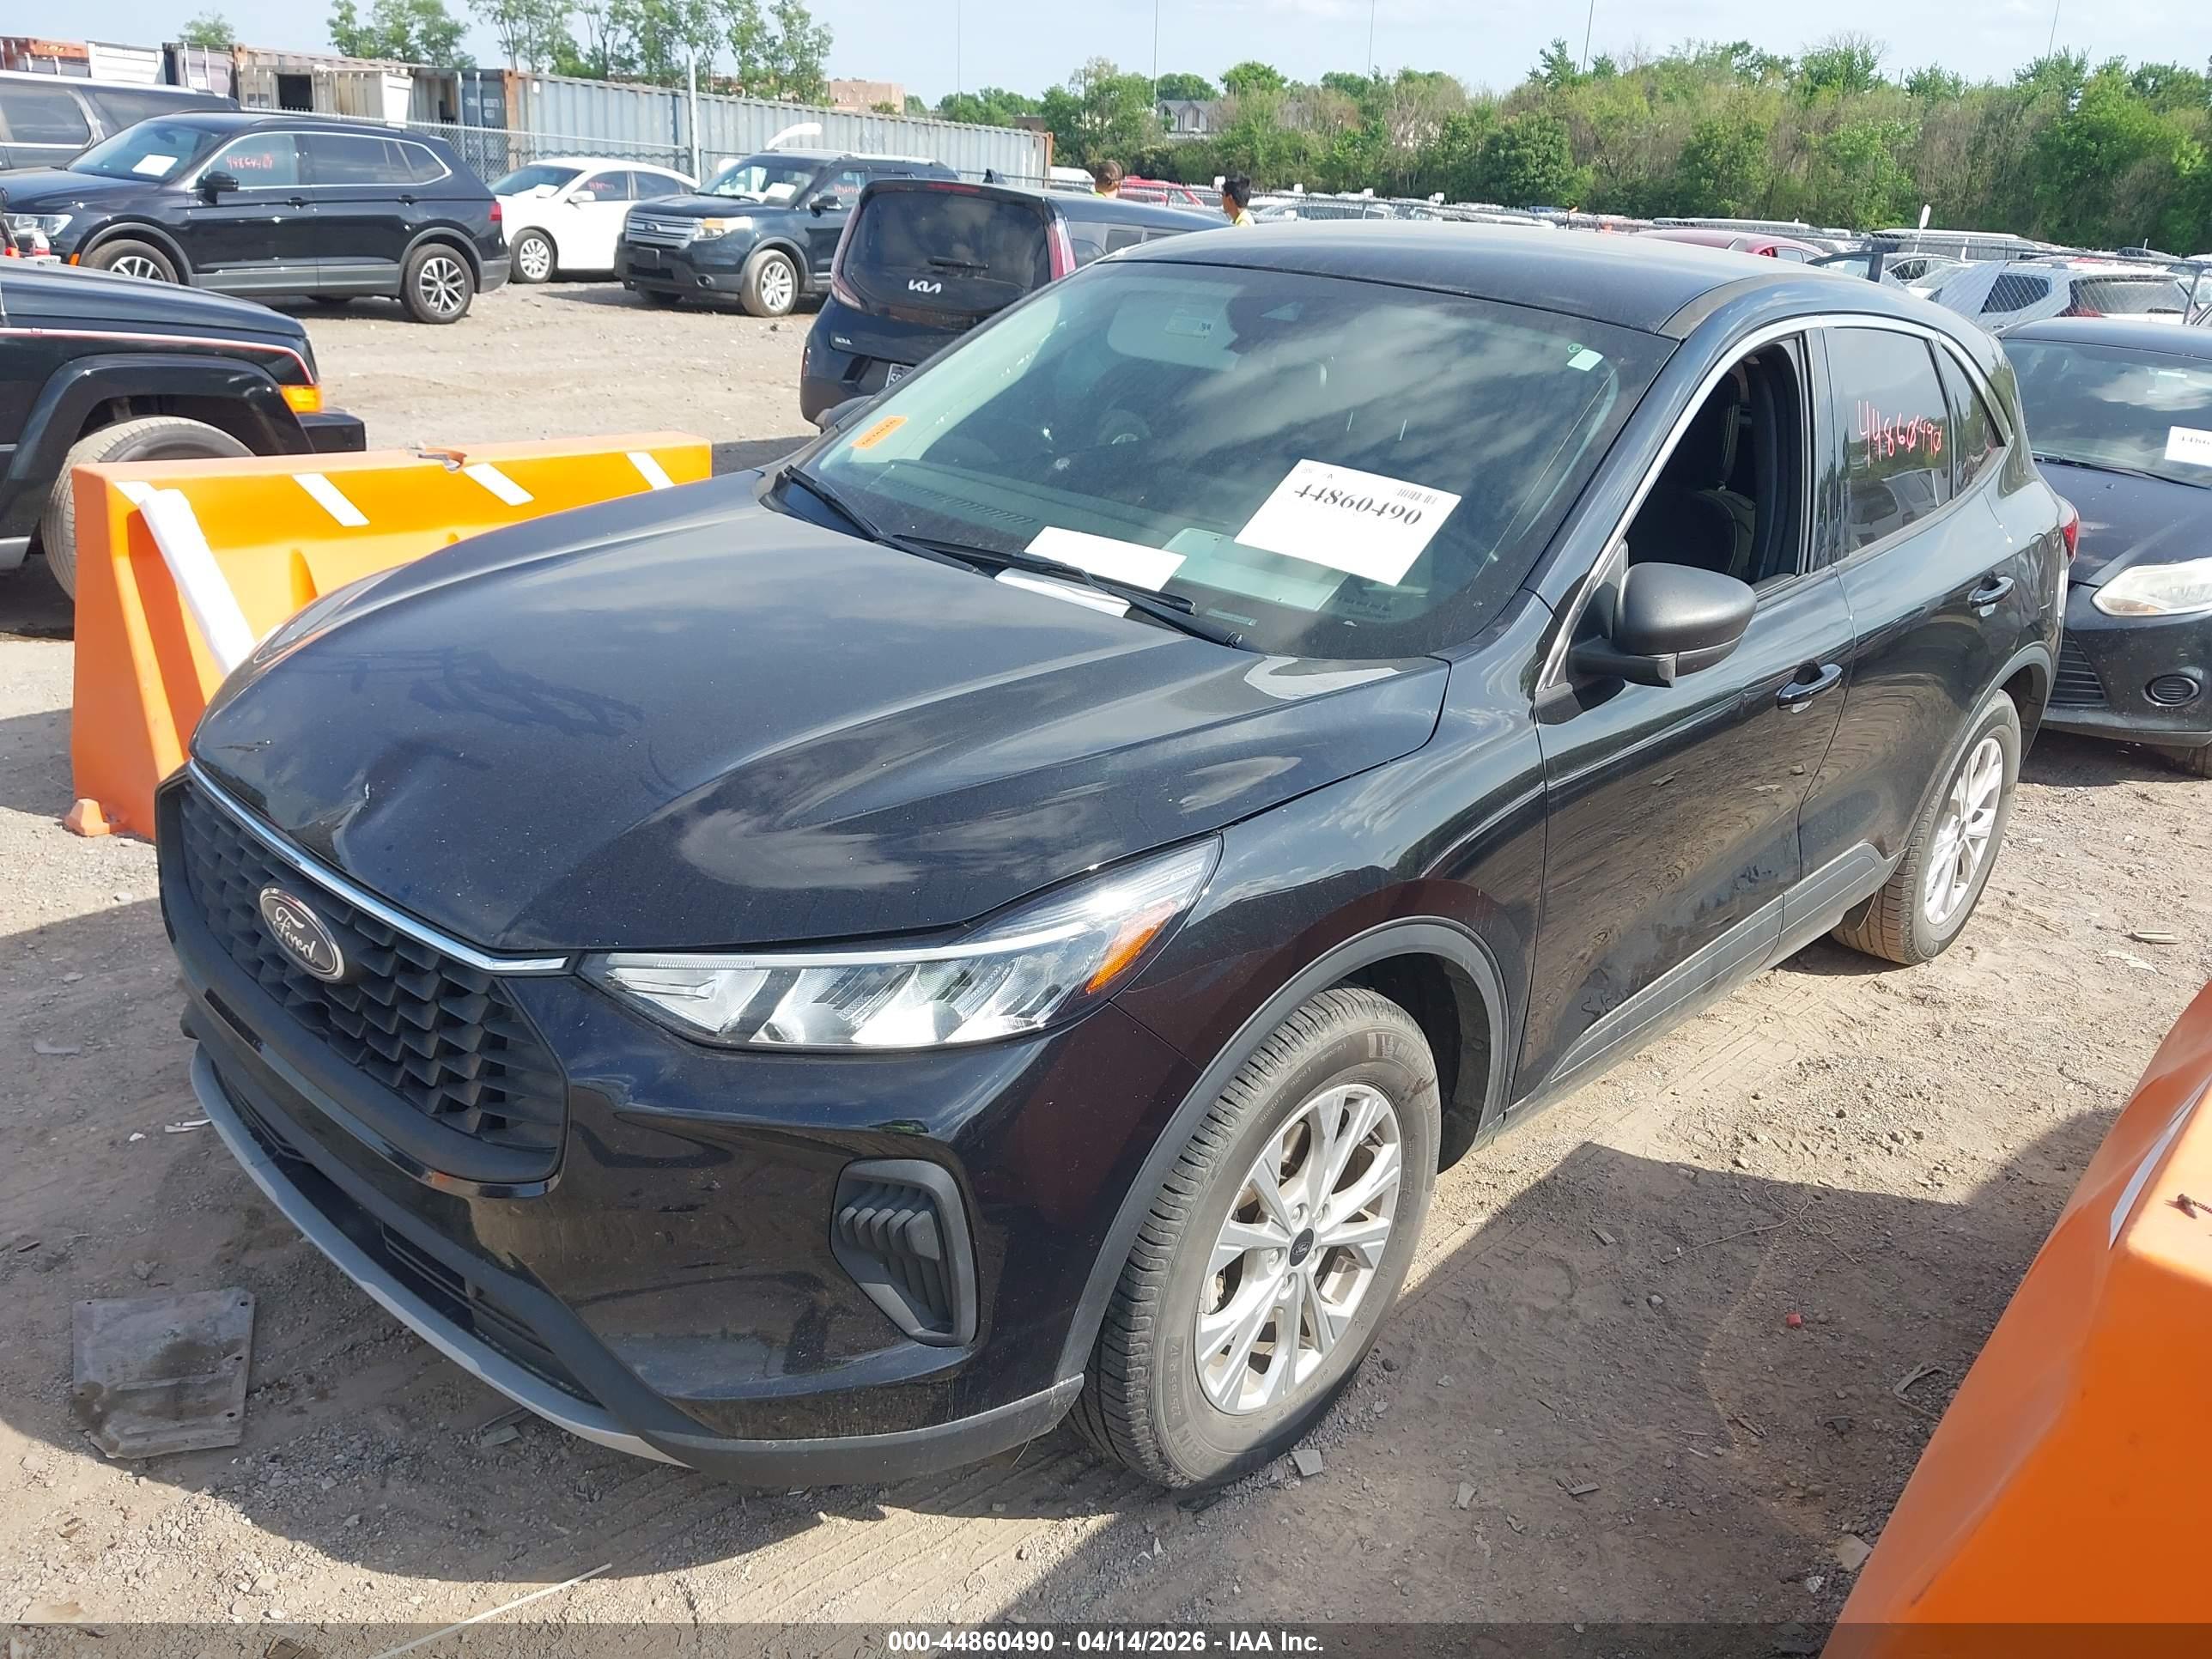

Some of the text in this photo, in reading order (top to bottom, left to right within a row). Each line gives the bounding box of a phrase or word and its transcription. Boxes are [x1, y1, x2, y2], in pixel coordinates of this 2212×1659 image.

[908, 278, 942, 294] KIA
[1294, 484, 1422, 525] 44860490
[272, 906, 317, 963] Ford
